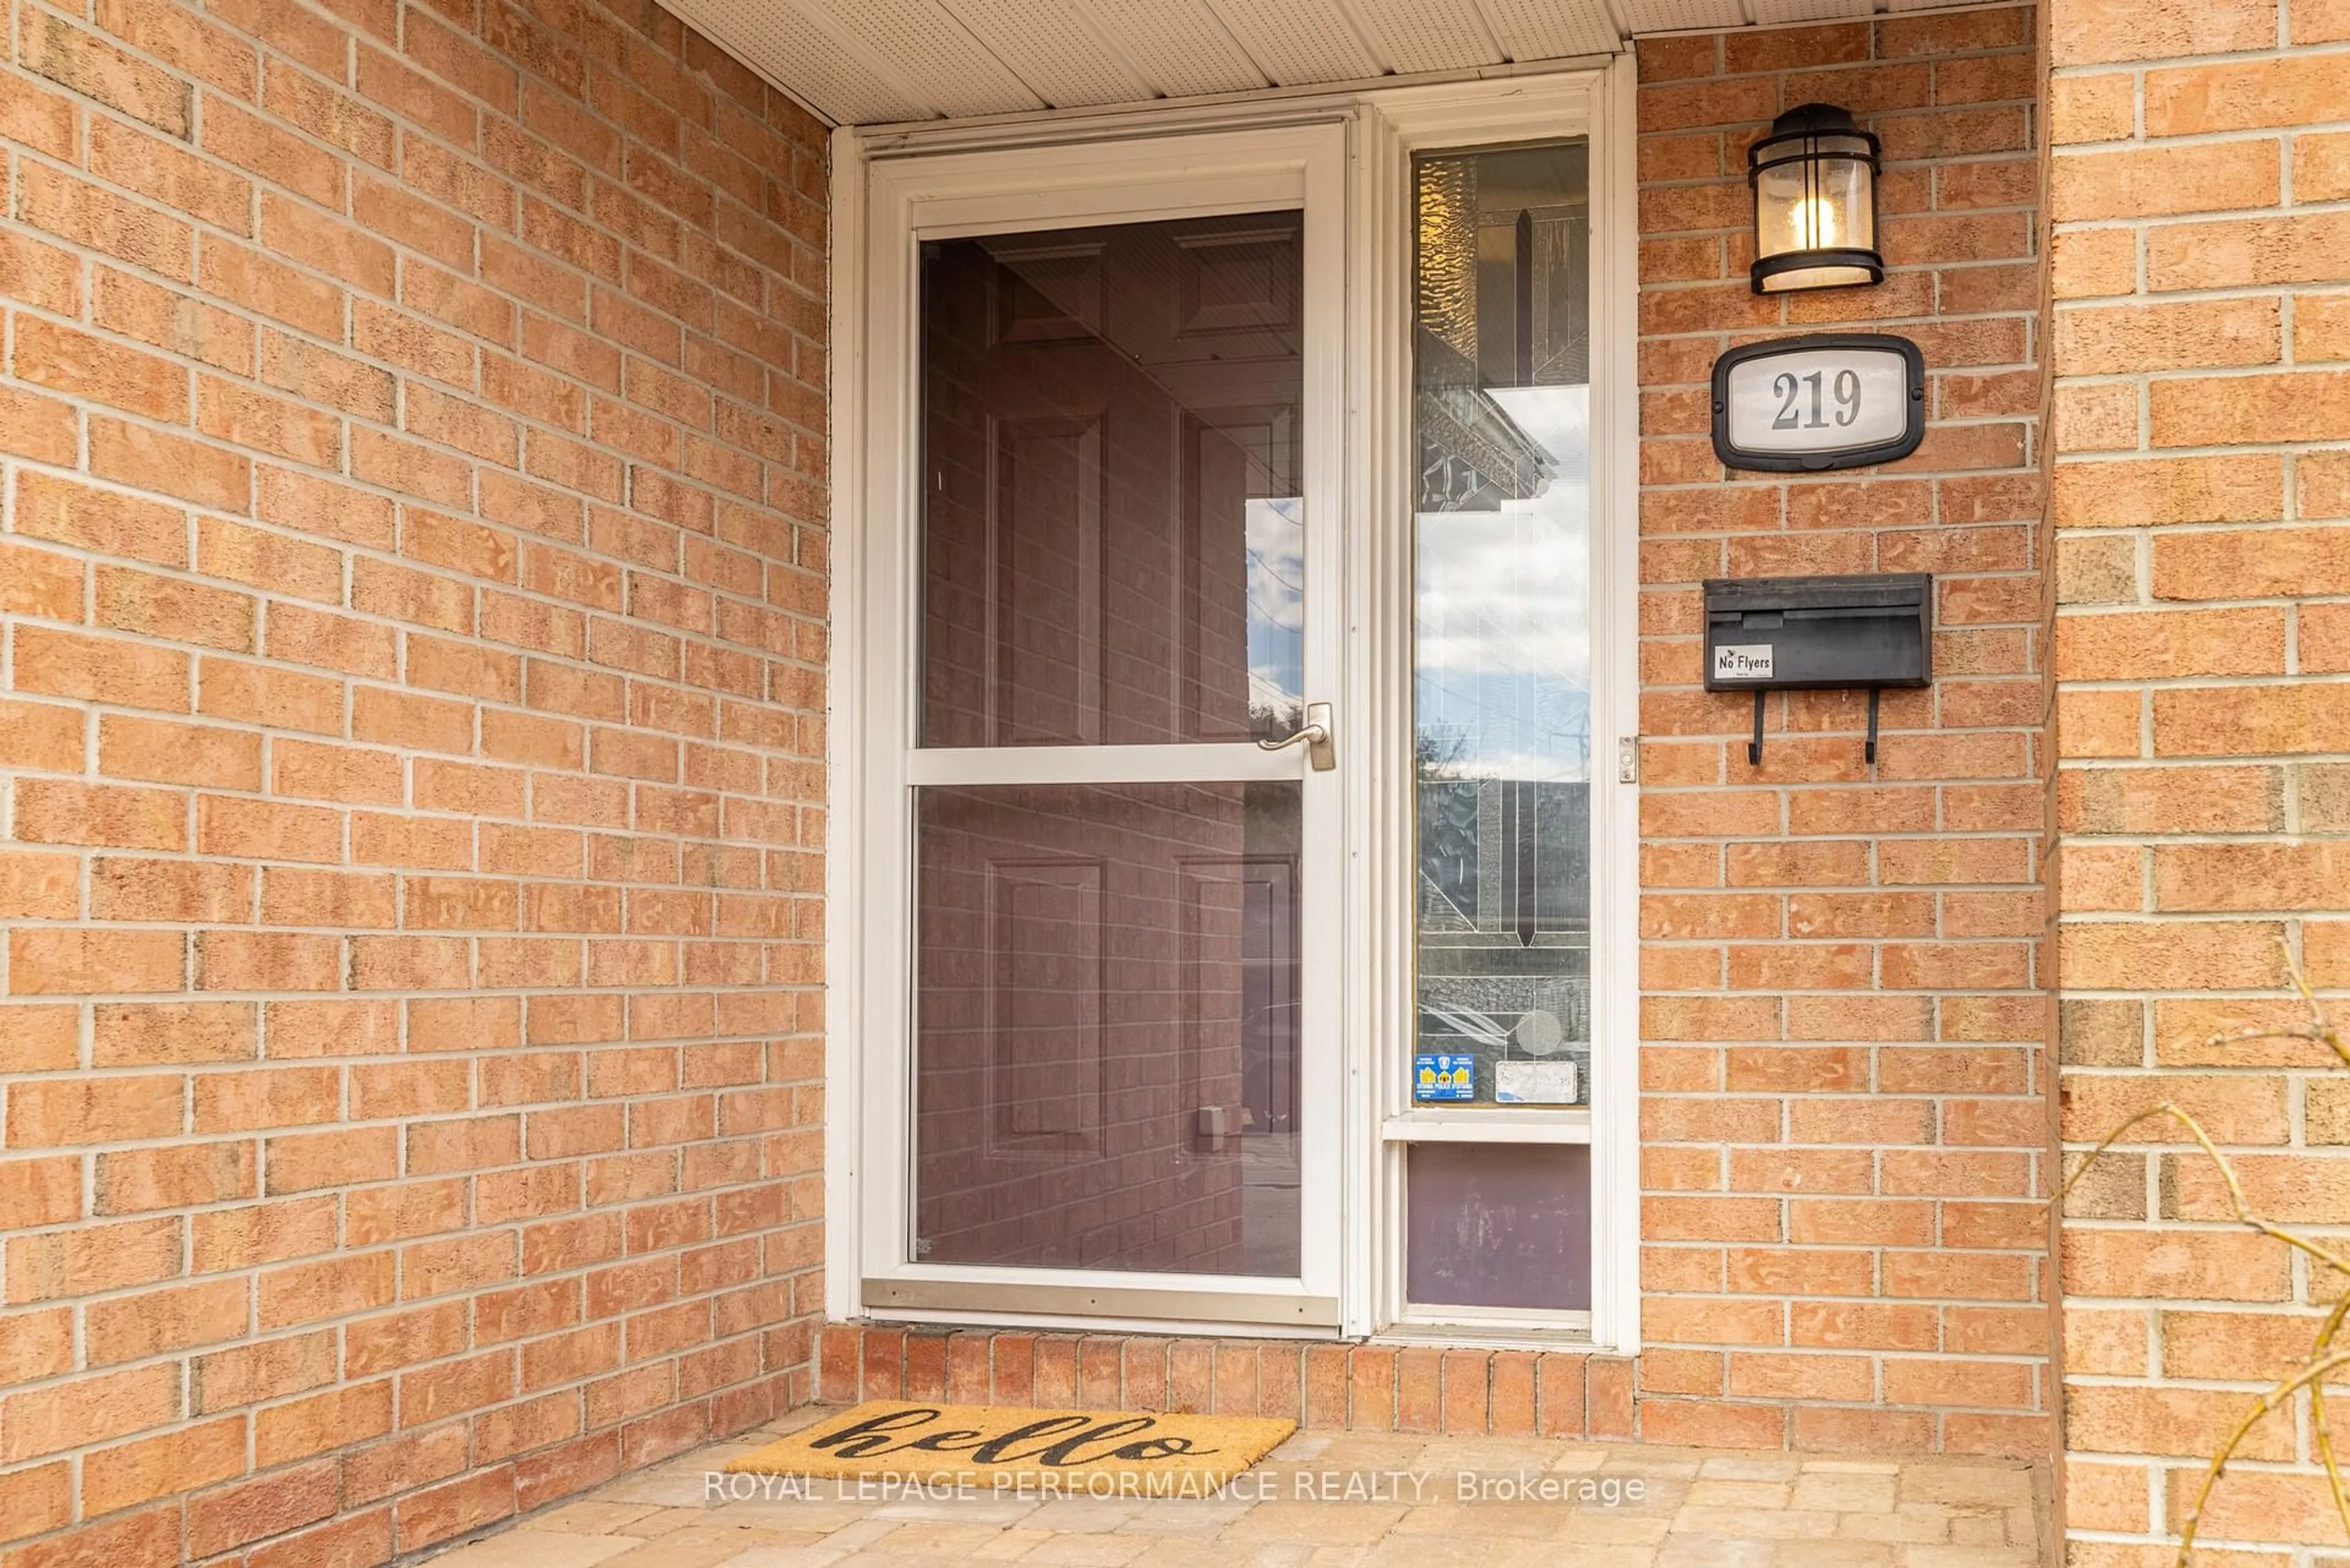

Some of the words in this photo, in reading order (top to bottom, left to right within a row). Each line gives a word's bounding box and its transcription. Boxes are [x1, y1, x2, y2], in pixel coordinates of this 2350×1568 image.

[1772, 369, 1862, 430] 219
[1720, 655, 1734, 669] No
[1737, 655, 1770, 671] Flyers
[808, 1408, 1219, 1467] hello
